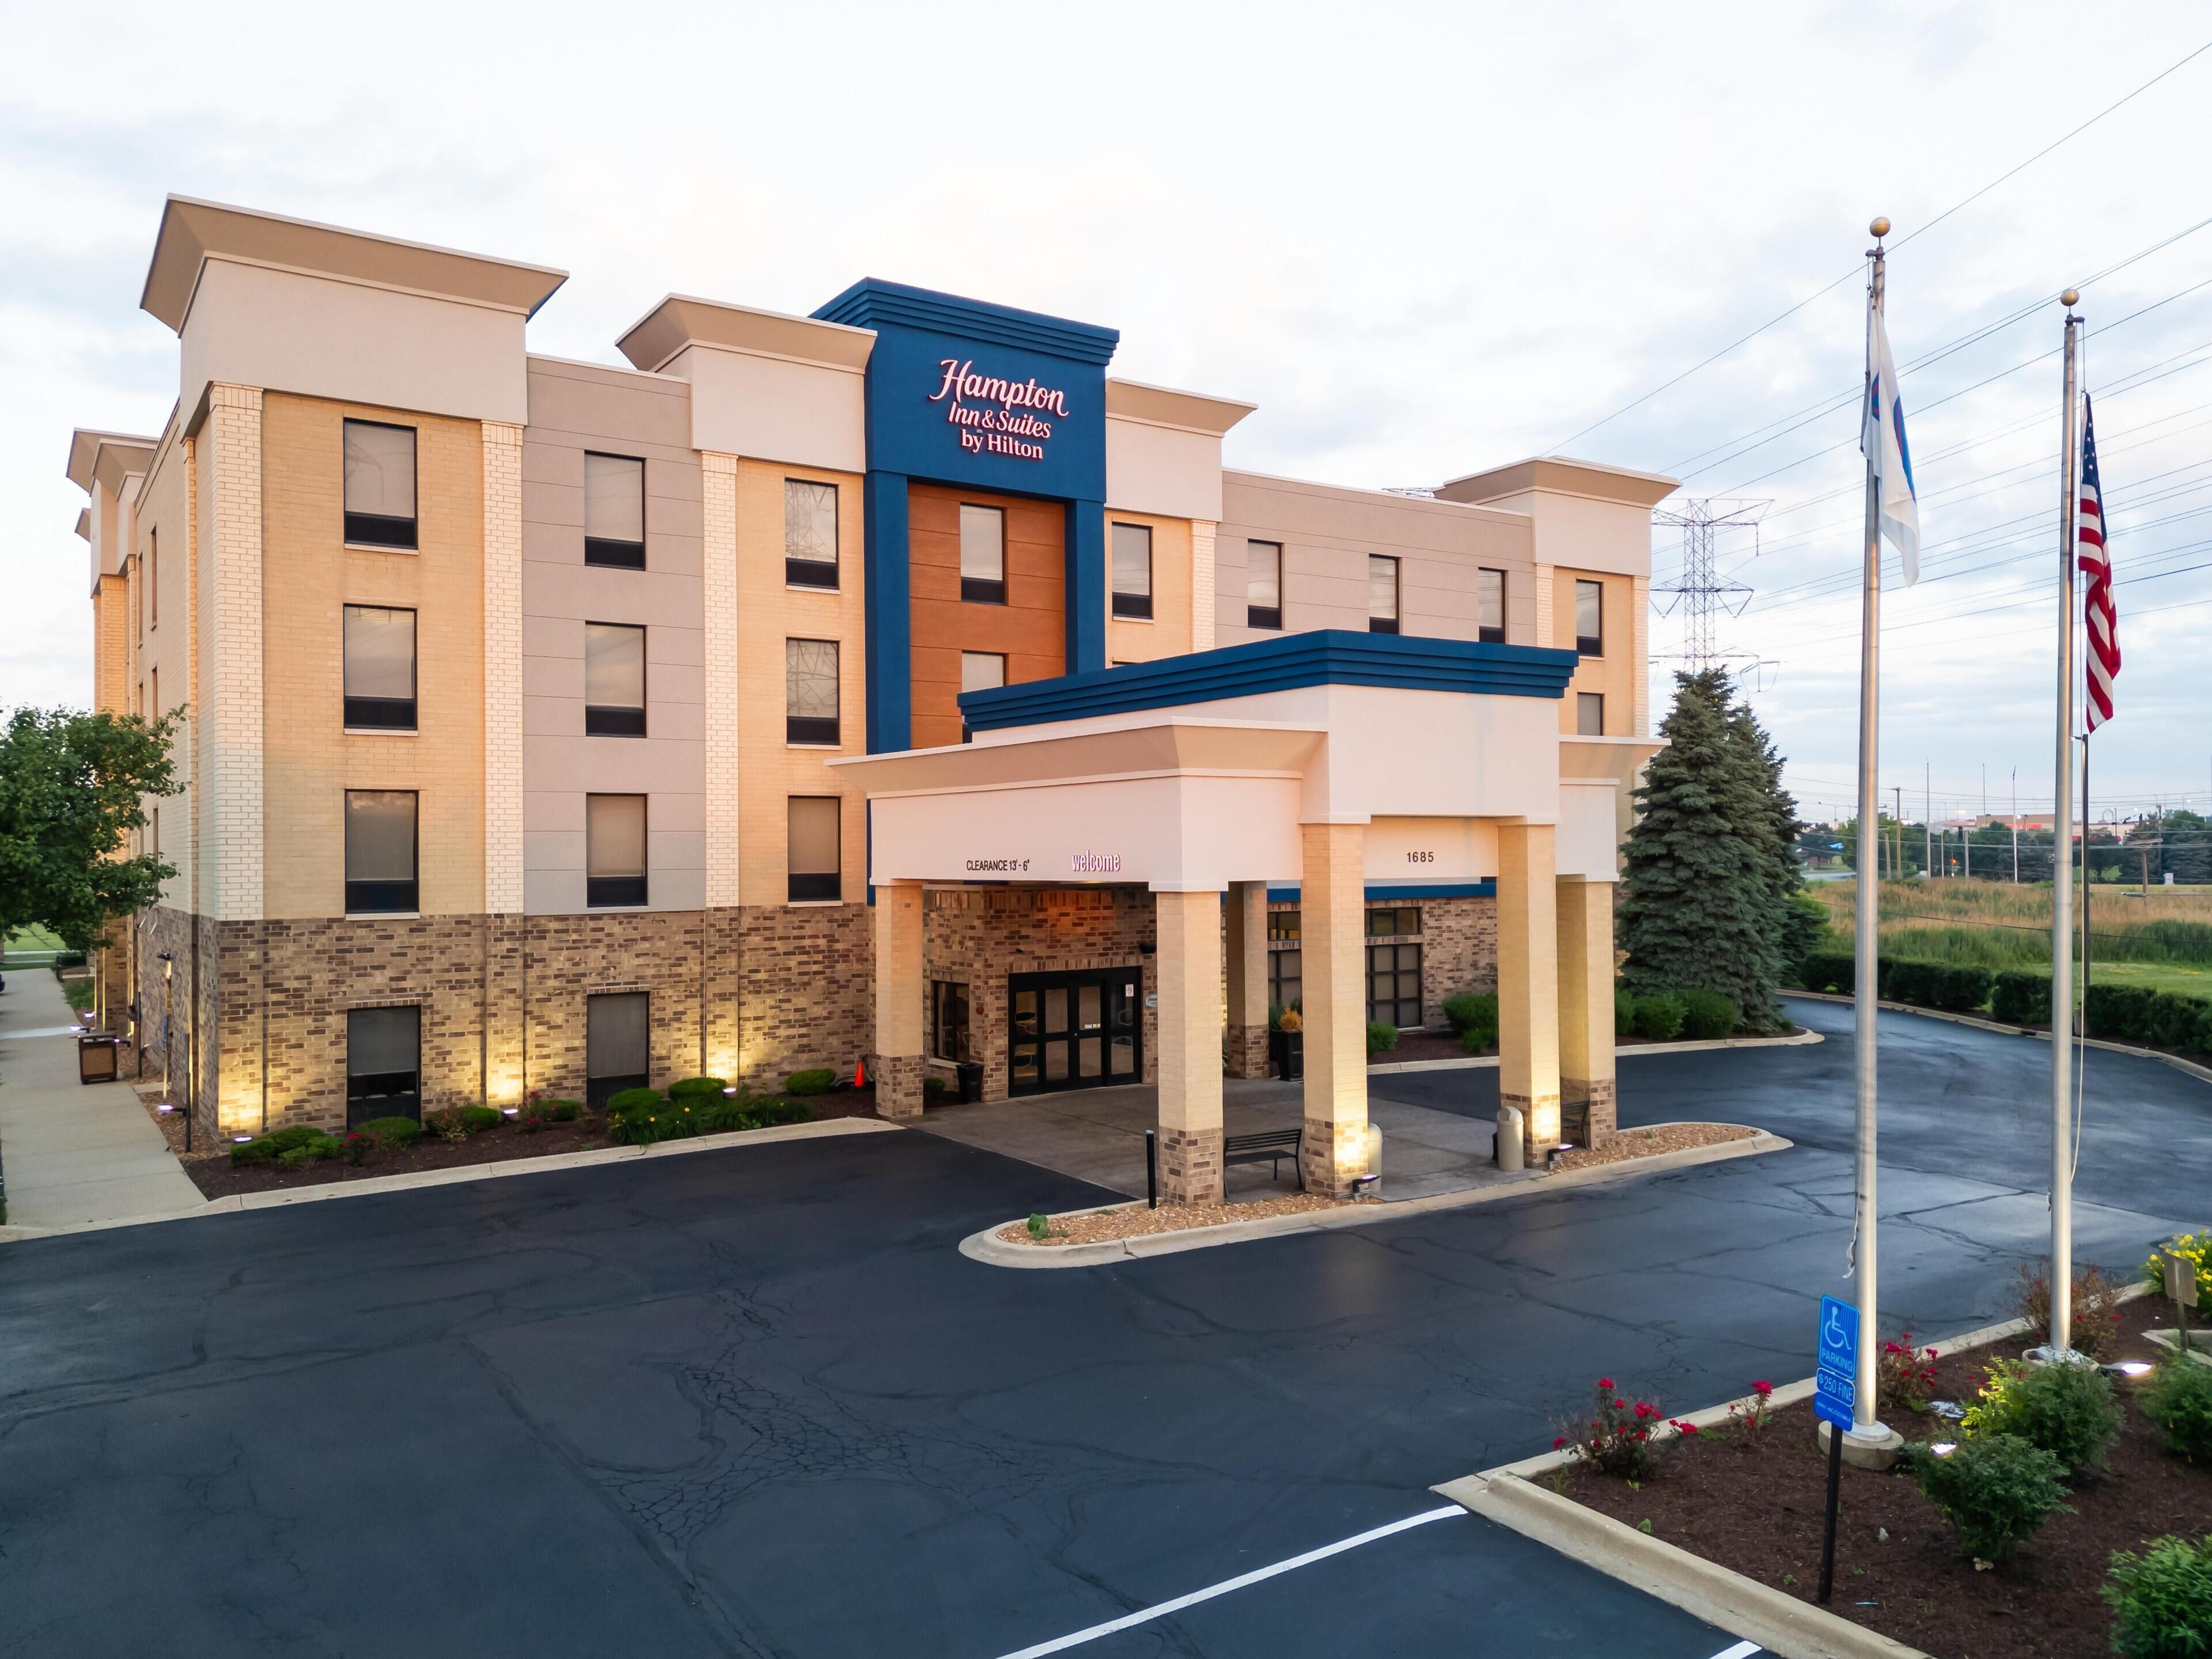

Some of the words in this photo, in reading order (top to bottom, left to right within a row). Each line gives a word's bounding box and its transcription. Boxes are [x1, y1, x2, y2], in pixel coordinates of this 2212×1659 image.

[929, 359, 1069, 416] Hampton
[949, 402, 980, 426] Inn
[996, 411, 1051, 438] Suites
[961, 429, 983, 453] by
[987, 434, 1043, 459] Hilton
[967, 860, 1007, 871] CLEARANCE
[1071, 850, 1121, 872] welcome
[1407, 851, 1434, 863] 1685
[1821, 1347, 1853, 1372] PARKING
[1838, 1382, 1853, 1402] FINE
